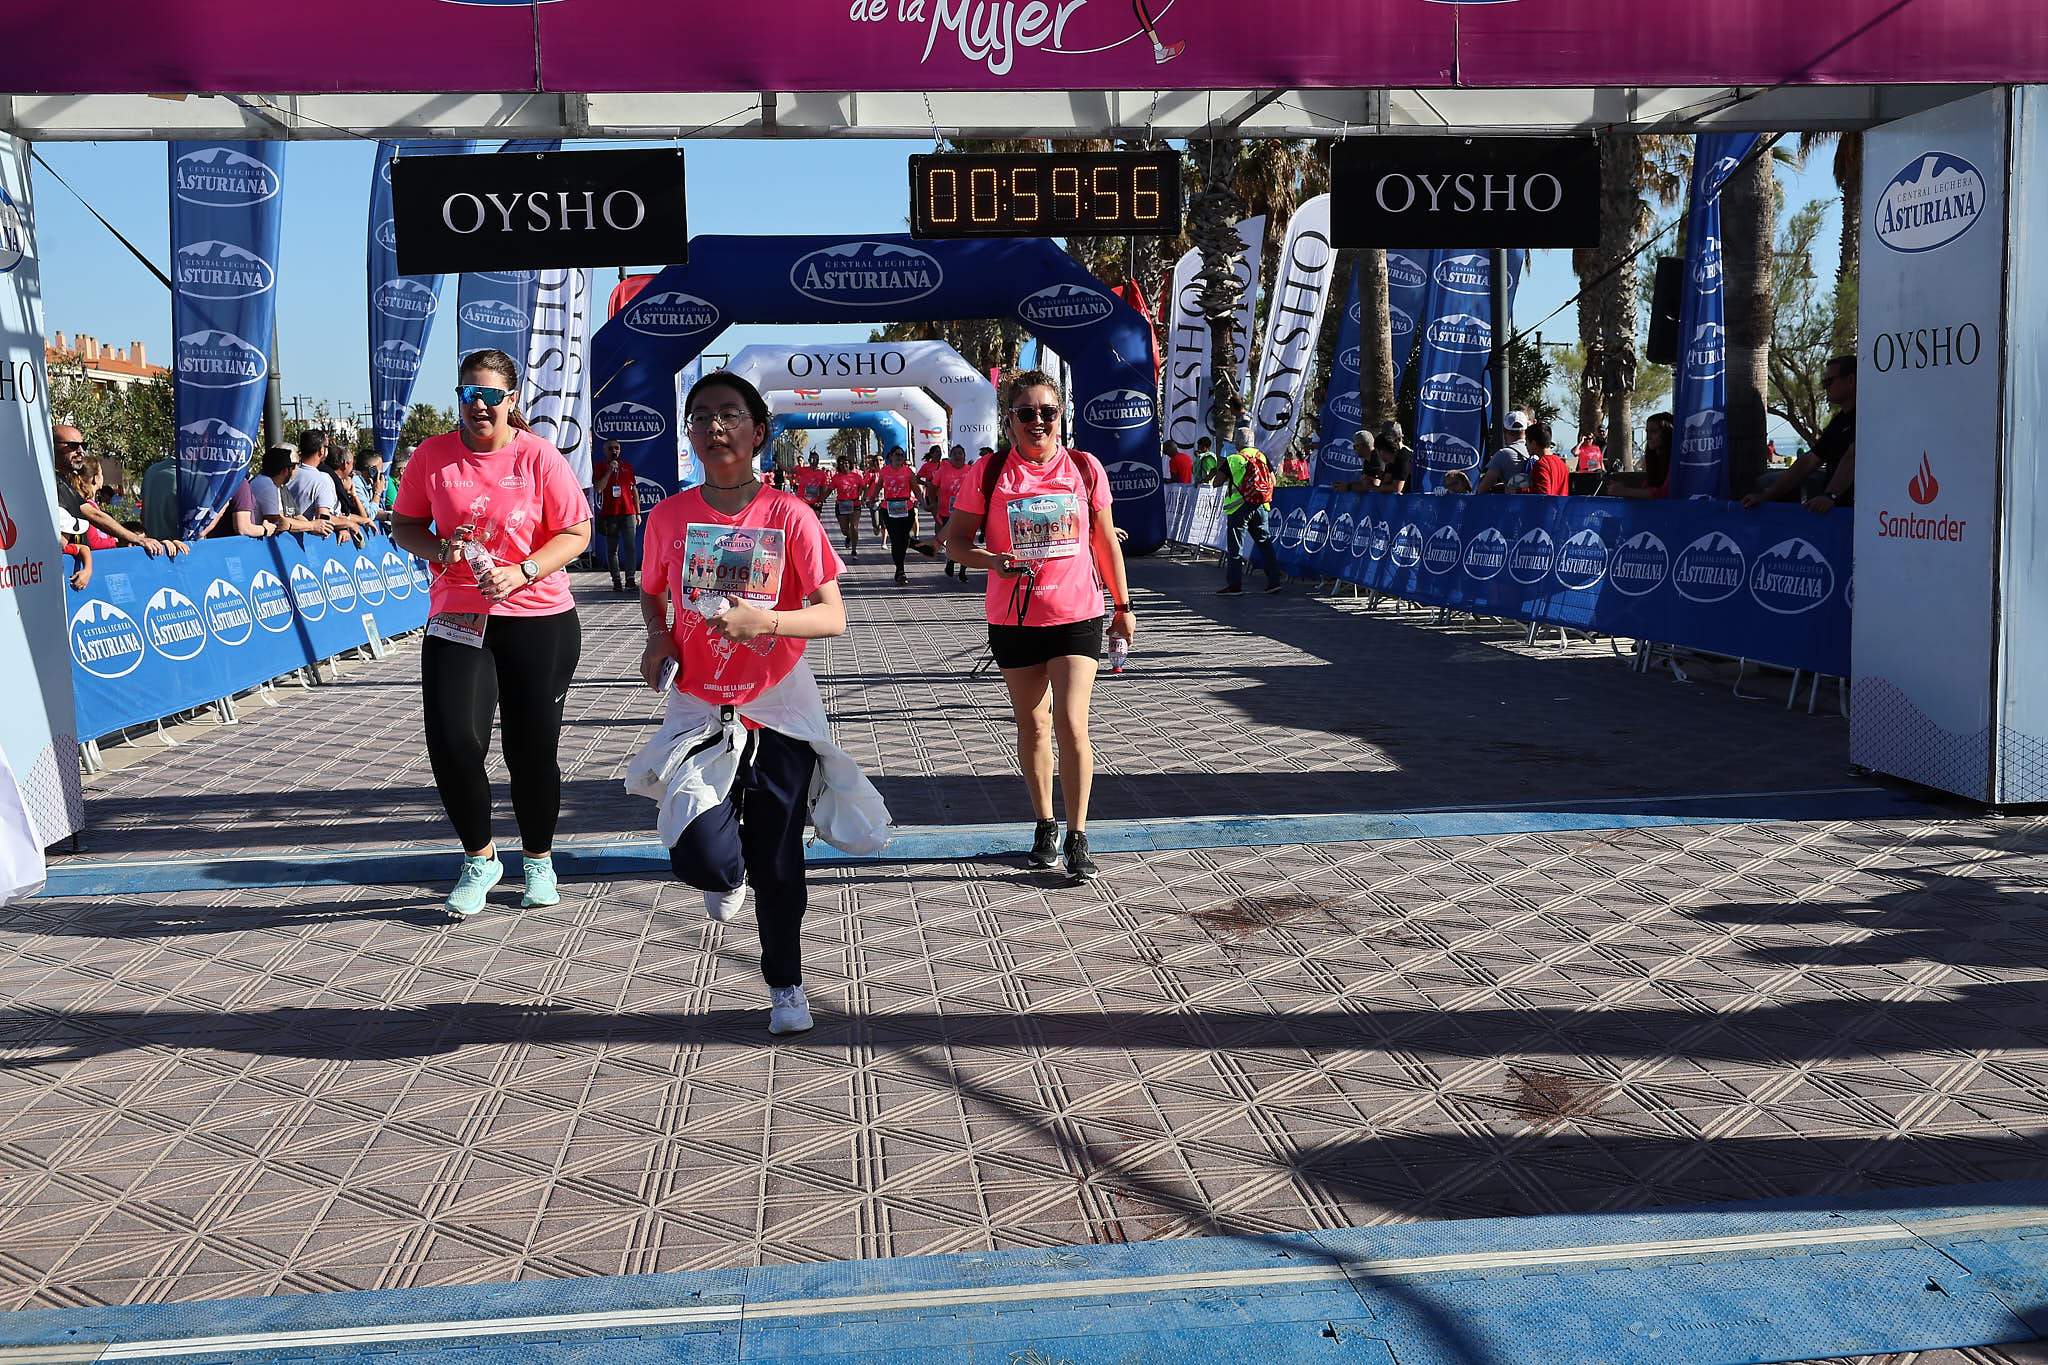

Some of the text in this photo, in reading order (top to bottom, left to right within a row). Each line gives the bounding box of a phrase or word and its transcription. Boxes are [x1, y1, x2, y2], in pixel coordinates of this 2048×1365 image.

[849, 0, 1089, 76] de la Mujer
[930, 166, 1159, 222] 00:59:56
[1375, 172, 1563, 213] OYSHO
[1896, 176, 1974, 203] CENTRAL LECHERA
[442, 189, 646, 234] OYSHO
[1881, 191, 1976, 235] ASTURIANA
[802, 262, 933, 290] ASTURIANA
[825, 259, 927, 268] CENTRAL LECHERA
[1438, 266, 1490, 285] ASTURIA
[464, 307, 525, 328] ASTURIANA
[630, 310, 712, 325] ASTURIANA
[1026, 302, 1107, 320] ASTURIANA
[1257, 230, 1331, 431] OYSHO
[1873, 322, 1981, 373] OYSHO
[787, 351, 906, 378] OYSHO
[939, 376, 975, 384] OYSHO
[596, 417, 661, 433] ASTURIANA
[1088, 405, 1152, 422] ASTURIANA
[960, 424, 992, 433] OYSHO
[442, 480, 474, 488] OYSHO
[1109, 477, 1157, 491] TURIANA
[1878, 510, 1967, 542] Santander
[1466, 546, 1503, 568] ASTURIANA
[1512, 547, 1550, 571] ASTURIANA
[1558, 550, 1602, 576] ASTURIANA
[1613, 554, 1663, 580] ASTURIANA
[716, 563, 750, 580] 016
[1677, 556, 1738, 587] ASTURIANA
[1753, 561, 1823, 599] ASTURIANA
[254, 596, 292, 620] ASTURIANA
[747, 592, 772, 600] VALENCIA
[83, 622, 132, 638] CENTRAL LECHERA
[150, 618, 204, 646] ASTURIANA
[208, 606, 251, 632] ASTURIANA
[77, 632, 142, 664] ASTURIANA
